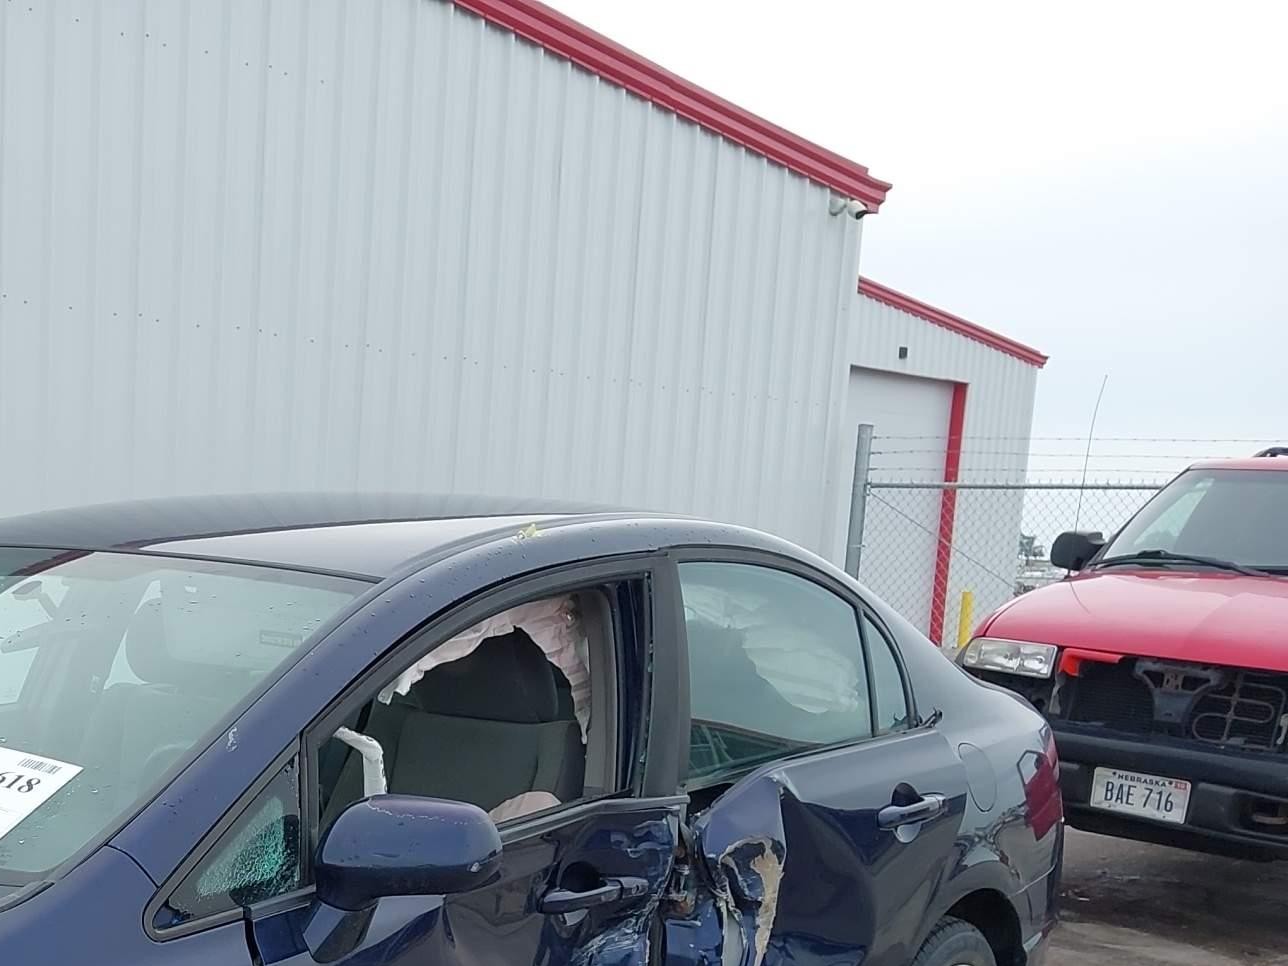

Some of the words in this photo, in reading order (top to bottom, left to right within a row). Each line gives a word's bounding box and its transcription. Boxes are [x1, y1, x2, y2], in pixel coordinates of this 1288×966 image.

[1117, 773, 1167, 788] NEBRASKA
[1104, 781, 1137, 806] BAE
[1143, 787, 1174, 813] 716
